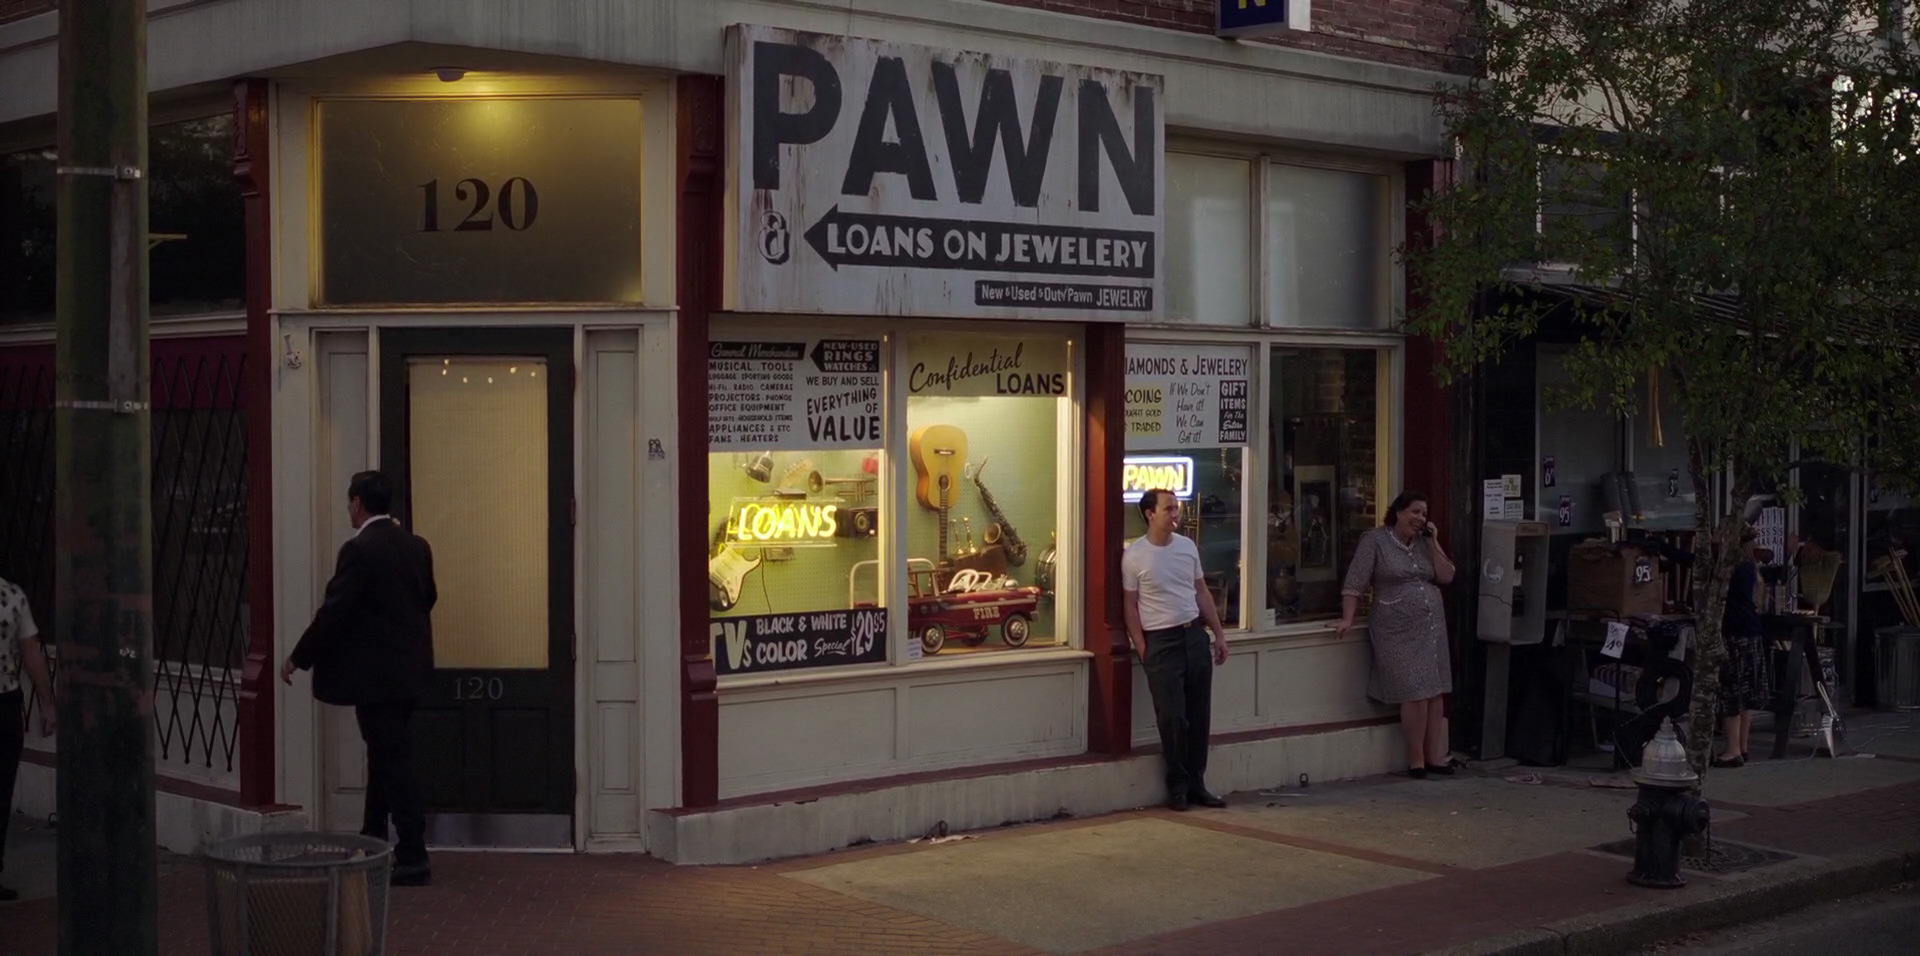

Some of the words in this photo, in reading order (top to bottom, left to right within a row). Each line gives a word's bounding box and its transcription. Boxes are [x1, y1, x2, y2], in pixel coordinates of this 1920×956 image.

[753, 41, 1155, 216] PAWN
[417, 177, 539, 232] 120
[758, 210, 790, 264] &
[827, 223, 934, 259] LOANS
[943, 229, 987, 261] ON
[995, 231, 1148, 269] JEWELERY
[981, 284, 1003, 301] New
[1010, 286, 1036, 301] Used
[1067, 287, 1093, 303] Pawn
[1096, 287, 1149, 307] JEWELRY
[824, 350, 874, 362] RINGS
[709, 362, 752, 371] MUSICAL
[761, 362, 793, 371] TOOLS
[823, 361, 869, 371] WATCHES
[909, 342, 1024, 392] Confidential
[1124, 357, 1176, 375] IAMONDS
[1180, 359, 1188, 375] &
[760, 383, 793, 391] CAMERAS
[806, 376, 819, 386] WE
[822, 376, 838, 386] BUY
[841, 376, 858, 386] AND
[860, 376, 879, 386] SELL
[997, 373, 1065, 394] LOANS
[1177, 382, 1188, 395] We
[1221, 382, 1246, 396] GIFT
[807, 387, 877, 415] EVERYTHING
[1124, 389, 1162, 404] COINS
[709, 404, 737, 412] OFFICE
[740, 403, 785, 411] EQUIPMENT
[866, 403, 878, 413] OF
[1220, 398, 1246, 410] ITEMS
[709, 424, 765, 432] APPLIANCES
[1131, 422, 1162, 432] TRADED
[1176, 414, 1187, 428] We
[808, 415, 880, 442] VALUE
[1220, 430, 1246, 441] FAMILY
[709, 435, 731, 443] FANS
[740, 434, 779, 442] HEATERS
[1123, 464, 1184, 491] PAWN
[738, 505, 837, 540] LOANS
[973, 606, 1000, 620] FIRE
[756, 615, 796, 636] BLACK
[798, 615, 808, 633] &
[811, 612, 848, 631] WHITE
[756, 639, 809, 665] COLOR
[814, 637, 851, 657] Special
[453, 676, 504, 701] 120
